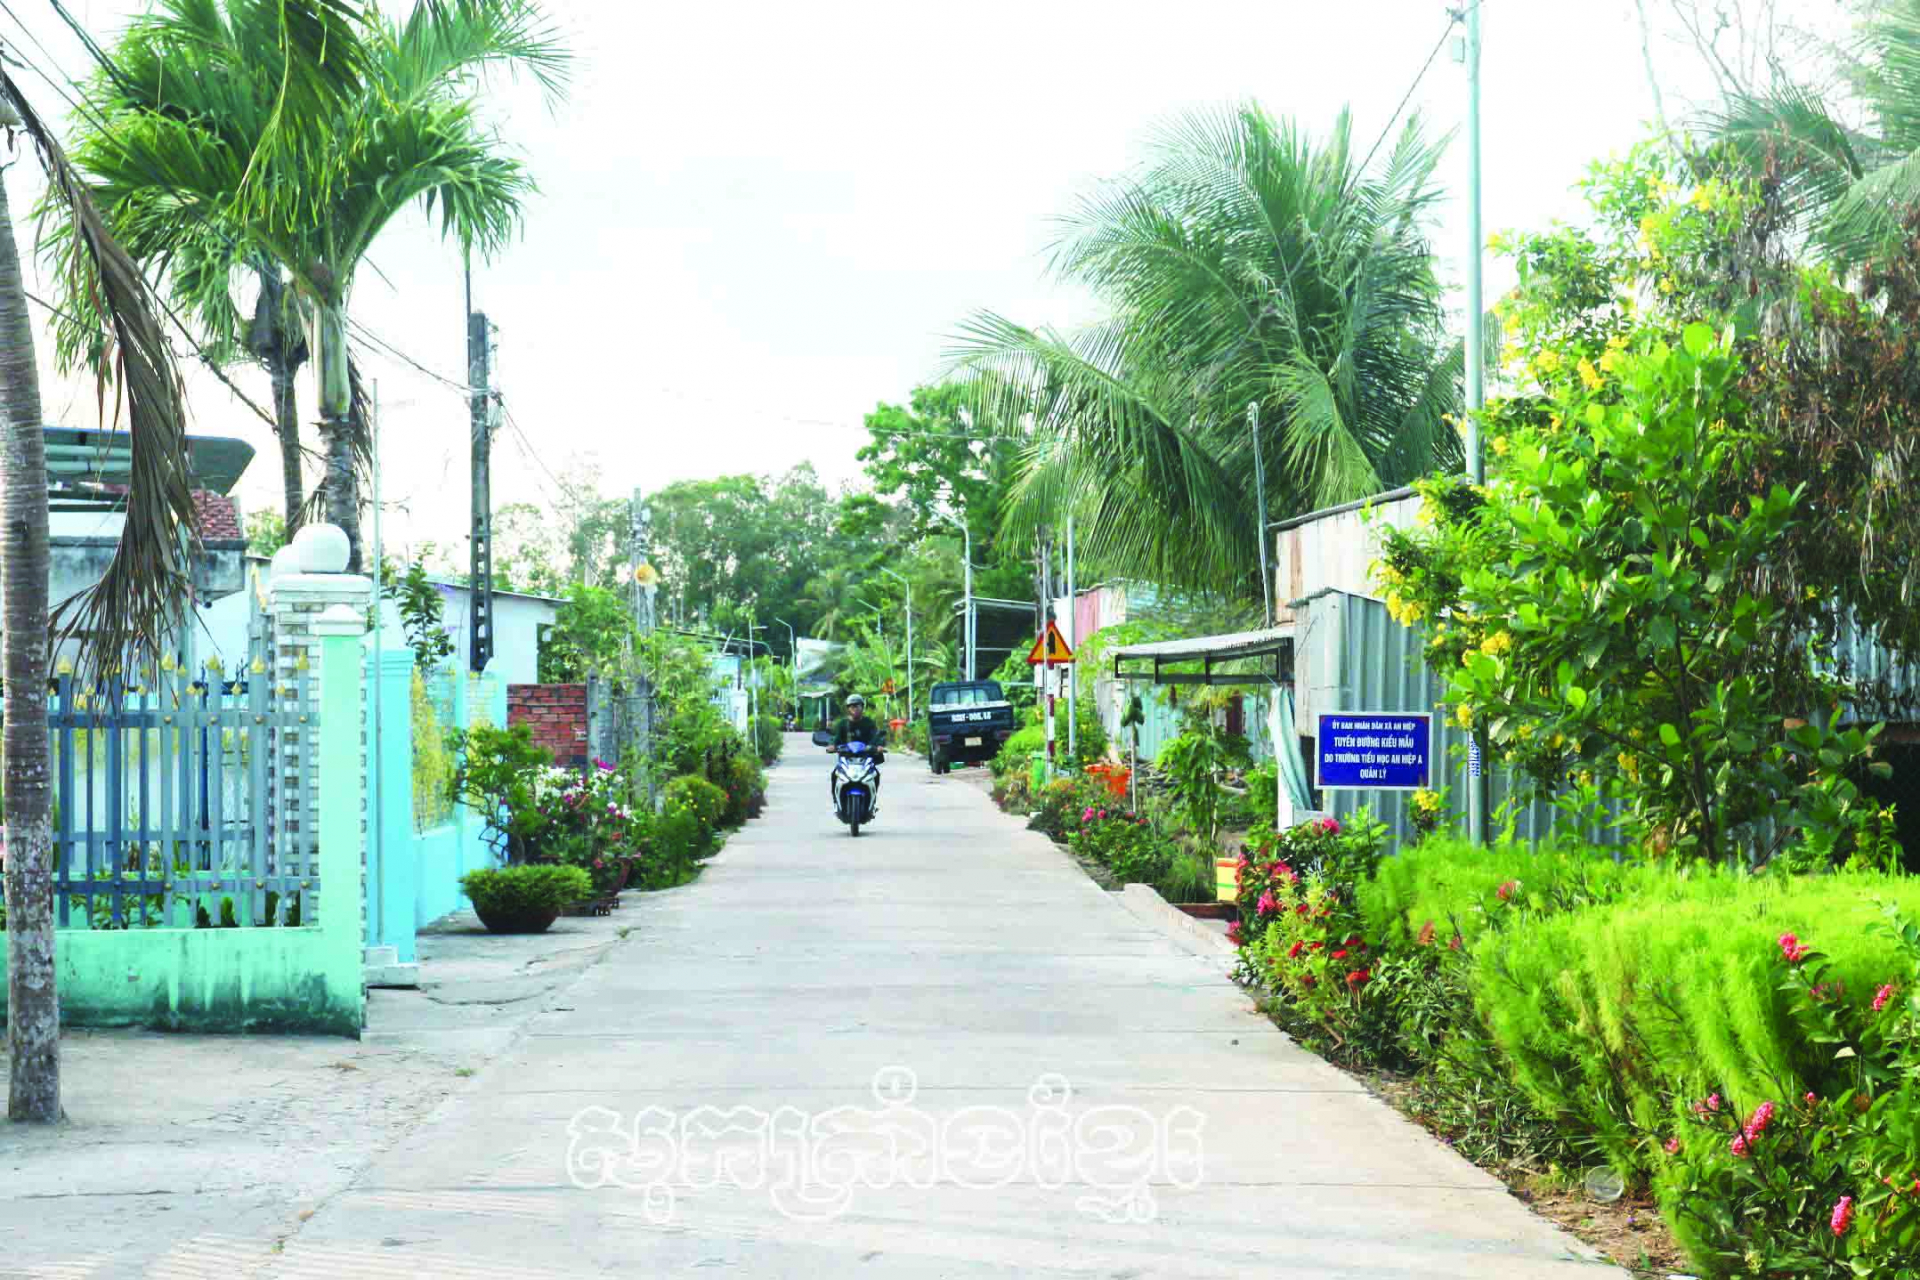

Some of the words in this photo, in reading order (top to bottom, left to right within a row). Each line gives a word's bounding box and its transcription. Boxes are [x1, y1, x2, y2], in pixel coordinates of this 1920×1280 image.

[1354, 720, 1370, 730] NHÂN
[1371, 720, 1384, 730] DÂN
[1393, 722, 1402, 730] AN
[1402, 721, 1416, 732] HIỆP
[1334, 734, 1356, 748] TUYẾN
[1356, 735, 1380, 748] ĐƯỜNG
[1324, 753, 1334, 763] DO
[1376, 754, 1390, 765] HỌC
[1391, 754, 1401, 764] AN
[1401, 752, 1417, 766] HIỆP
[1417, 754, 1423, 764] A
[1360, 766, 1378, 779] QUẢN
[1378, 766, 1387, 779] LÝ
